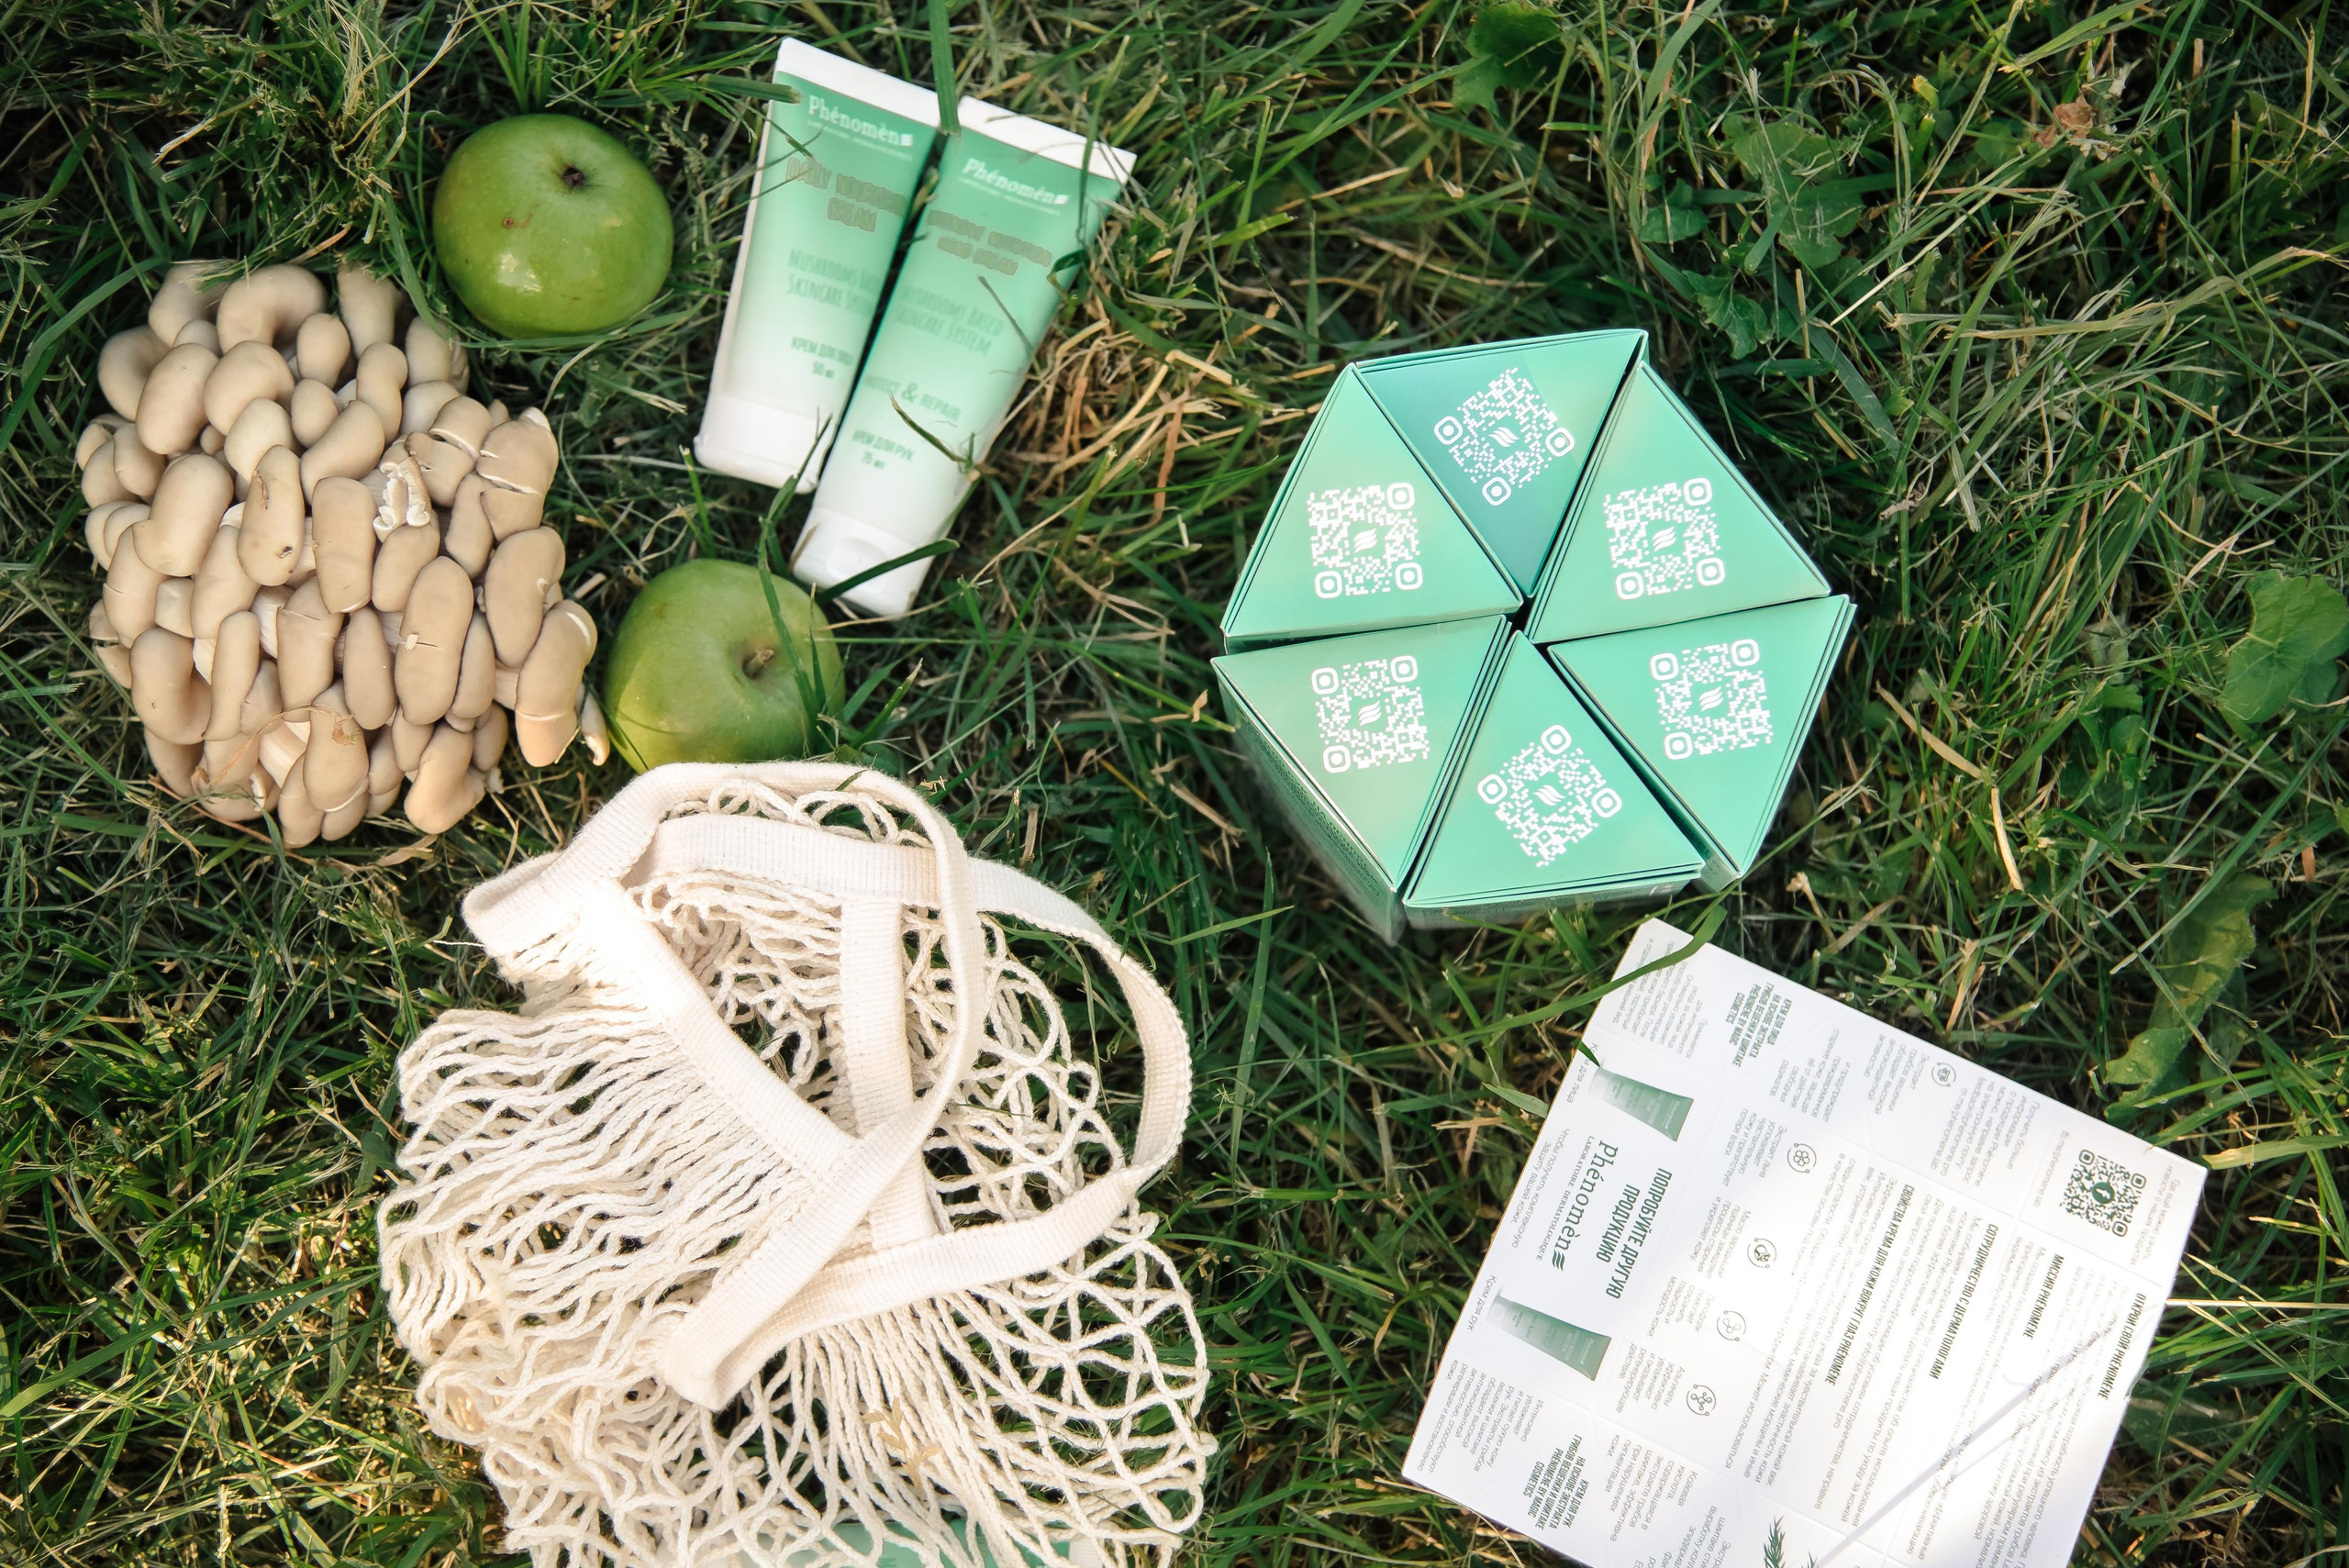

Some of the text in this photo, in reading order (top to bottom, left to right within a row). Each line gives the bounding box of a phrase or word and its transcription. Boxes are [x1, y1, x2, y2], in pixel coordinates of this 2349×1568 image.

[1724, 991, 1745, 1025] COSMETICS
[1771, 993, 1781, 1003] НА
[1777, 997, 1792, 1016] КРЕМ
[1565, 1042, 1598, 1104] Км для лица
[1743, 1111, 1757, 1130] кожу
[1751, 1120, 1776, 1166] успокаивает
[1720, 1137, 1746, 1186] препятствует
[1736, 1115, 1766, 1174] чувствительную
[1757, 1124, 1787, 1178] Экстракт льна
[1509, 1140, 1551, 1225] защиту вашей кожи.
[1509, 1127, 1569, 1249] Чтобы получить комплексную
[1534, 1135, 1594, 1262] LABORATOIRE DERMATOLOGIQUE
[1889, 1183, 1916, 1223] СВОЙСТВА
[1593, 1183, 1641, 1263] ПРОДУКЦИЮ
[1626, 1166, 1673, 1248] ПОПРОБУЙТЕ
[1697, 1202, 1719, 1240] укрепляет
[1687, 1240, 1703, 1262] кожу.
[1695, 1199, 1731, 1273] процессы старения
[1872, 1247, 1889, 1266] ДЛЯ
[1879, 1221, 1900, 1249] КРЕМА
[1604, 1243, 1640, 1300] ДРУГУЮ
[1863, 1264, 1882, 1289] КОЖИ
[1959, 1222, 1998, 1297] СОТРУДНИЧЕСТВО
[2042, 1253, 2065, 1290] МИССИЯ
[1465, 1273, 1497, 1332] Крем для рук
[1851, 1287, 1873, 1318] ВОКРУГ
[2125, 1292, 2148, 1327] ОТКРОЙ
[1842, 1317, 1861, 1340] ГЛАЗ
[1927, 1303, 1966, 1379] ДЕРМАТОЛОГАМИ
[2116, 1325, 2135, 1350] СВОЙ
[1613, 1347, 1647, 1414] регенерирующее
[1616, 1342, 1638, 1381] действие.
[1631, 1359, 1653, 1401] оказывают
[1642, 1356, 1665, 1399] увлажняют
[1443, 1362, 1468, 1407] регенерации
[1453, 1371, 1486, 1439] антиоксидантной
[1486, 1380, 1505, 1415] вешенки
[1649, 1361, 1675, 1410] эффективно
[1663, 1365, 1685, 1407] Альгинаты
[1753, 1329, 1820, 1483] восстанавливает эластичность кожи
[1426, 1367, 1477, 1473] активностью, способствуют
[1460, 1376, 1496, 1449] обладают высокой
[1472, 1385, 1515, 1473] рук. Экстракты грибов
[1505, 1396, 1521, 1422] питает
[1511, 1394, 1532, 1435] увлажняет
[1520, 1398, 1543, 1443] Интенсивно
[1764, 1341, 1828, 1488] ухода за чувствительной кожей век.
[1416, 1413, 1446, 1472] восстановлению
[1468, 1421, 1488, 1455] шиитаке
[1486, 1446, 1499, 1467] кожу
[1494, 1422, 1510, 1447] сухую
[1564, 1433, 1582, 1461] ГРИБОВ
[1605, 1433, 1620, 1459] кожи.
[1521, 1460, 1544, 1498] COSMETICS
[1550, 1459, 1571, 1493] ВЕШЕНКИ
[1603, 1438, 1631, 1493] пигментации
[1608, 1443, 1642, 1513] при нарушениях
[1839, 1397, 1894, 1522] продукты по уходу за кожей
[1850, 1413, 1901, 1527] об опыте использования
[1535, 1485, 1548, 1497] BY
[1547, 1455, 1586, 1529] НА ОСНОВЕ ЭКСТРАКТА
[1561, 1478, 1589, 1528] КРЕМ ДЛЯ РУК
[1609, 1448, 1653, 1542] шиитаке, эффективна
[1628, 1453, 1664, 1529] экстракте грибов
[1642, 1459, 1675, 1523] содержащаяся
[1664, 1464, 1686, 1501] кислота,
[1676, 1470, 1698, 1507] Койевая
[1526, 1495, 1543, 1518] MAGIC
[1533, 1496, 1555, 1530] ШИИТАКЕ
[1970, 1496, 1994, 1541] здоровой.
[2004, 1477, 2041, 1558] экстрактов грибов
[2017, 1475, 2055, 1560] успешного человека.
